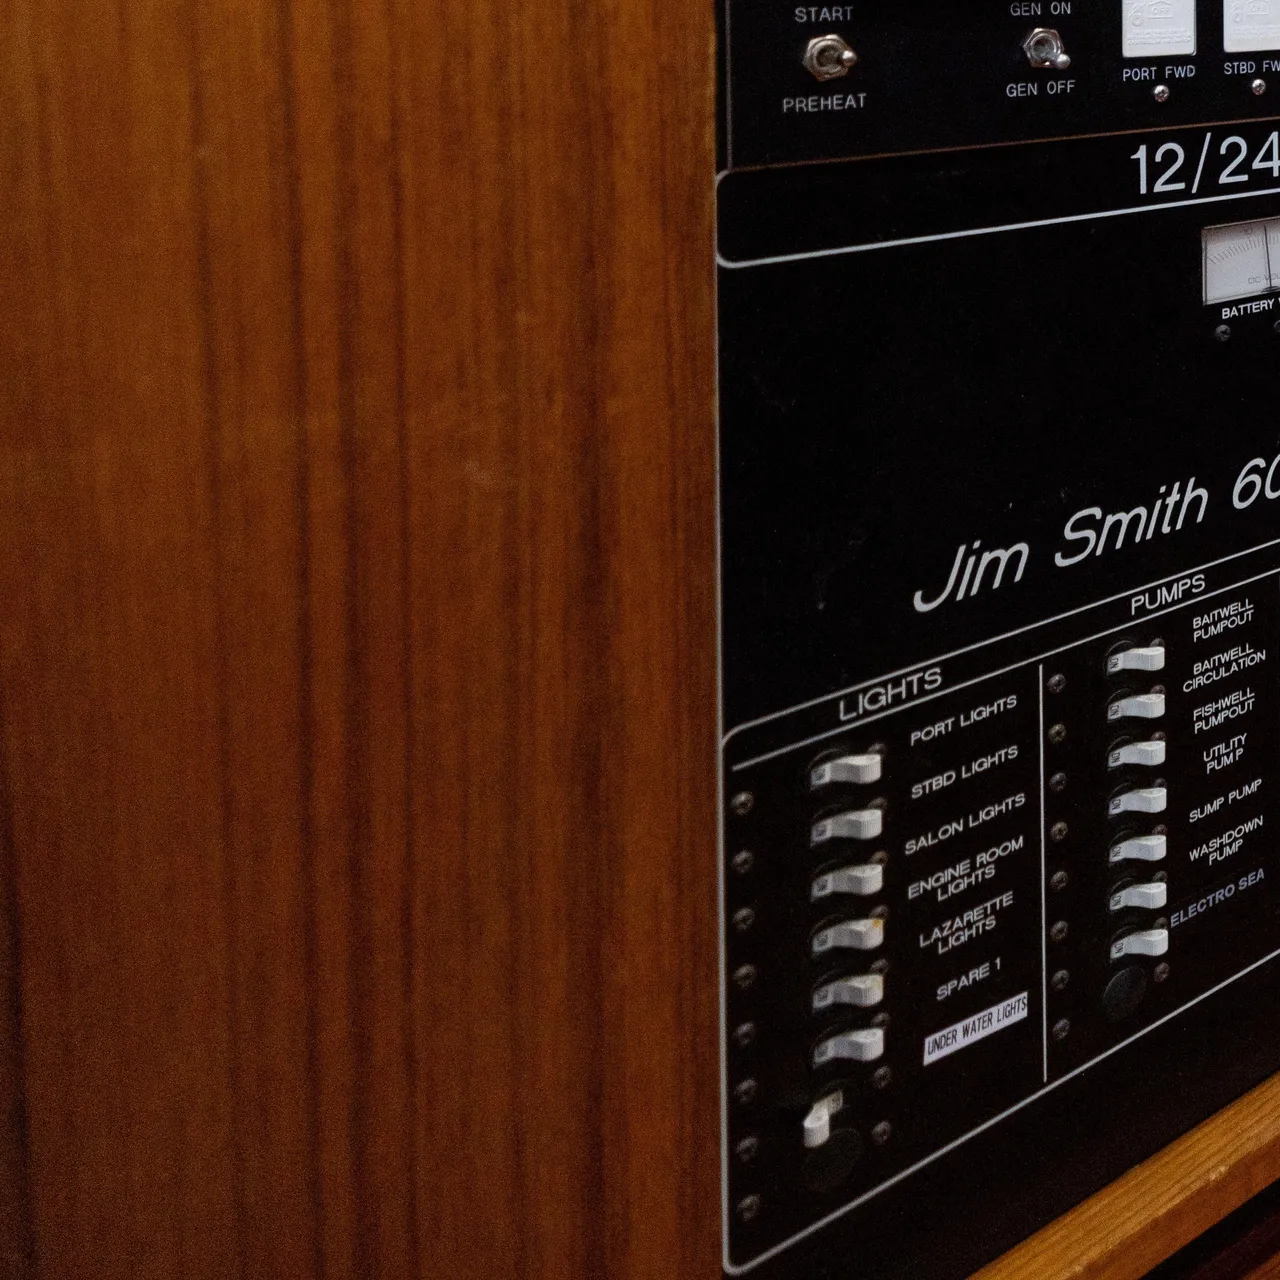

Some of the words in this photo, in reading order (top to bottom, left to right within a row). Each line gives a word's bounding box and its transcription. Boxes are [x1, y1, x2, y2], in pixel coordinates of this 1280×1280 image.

[794, 6, 854, 23] START
[1009, 2, 1042, 17] GEN
[1050, 1, 1071, 15] ON
[1122, 67, 1157, 81] PORT
[1165, 65, 1196, 80] FWD
[1223, 61, 1256, 75] STBD
[783, 93, 867, 114] PREHEAT
[1005, 82, 1039, 98] GEN
[1046, 80, 1077, 95] OFF
[1221, 298, 1275, 320] BATTERY
[913, 539, 1030, 613] Jim
[1054, 476, 1209, 568] Smith
[1131, 573, 1206, 616] PUMPS
[1193, 598, 1254, 630] BAITWELL
[1193, 609, 1255, 643] PUMPOUT
[1183, 649, 1267, 693] CIRCULATION
[1193, 642, 1255, 676] BAITWELL
[839, 667, 943, 721] LIGHTS
[1193, 686, 1255, 721] FISHWELL
[911, 716, 955, 746] PORT
[960, 694, 1018, 728] LIGHTS
[1194, 698, 1256, 735] PUMPOUT
[1203, 732, 1248, 762] UTILITY
[911, 770, 956, 800] STBD
[961, 745, 1019, 780] LIGHTS
[1189, 796, 1225, 823] SUMP
[1228, 778, 1263, 805] PUMP
[904, 818, 964, 856] SALON
[968, 792, 1026, 828] LIGHTS
[1189, 815, 1264, 862] WASHDOWN
[907, 858, 971, 900] ENGINE
[975, 835, 1024, 868] ROOM
[1208, 838, 1244, 866] PUMP
[937, 865, 996, 902] LIGHTS
[1170, 883, 1235, 929] ELECTRO
[1238, 867, 1266, 892] SEA
[919, 890, 1014, 949] LAZARETTE
[937, 914, 997, 955] LIGHTS
[936, 962, 991, 1002] SPARE
[994, 956, 1001, 971] 1
[926, 1028, 958, 1056] UNDER
[961, 1012, 994, 1039] WATER
[996, 994, 1029, 1024] LIGHTS
